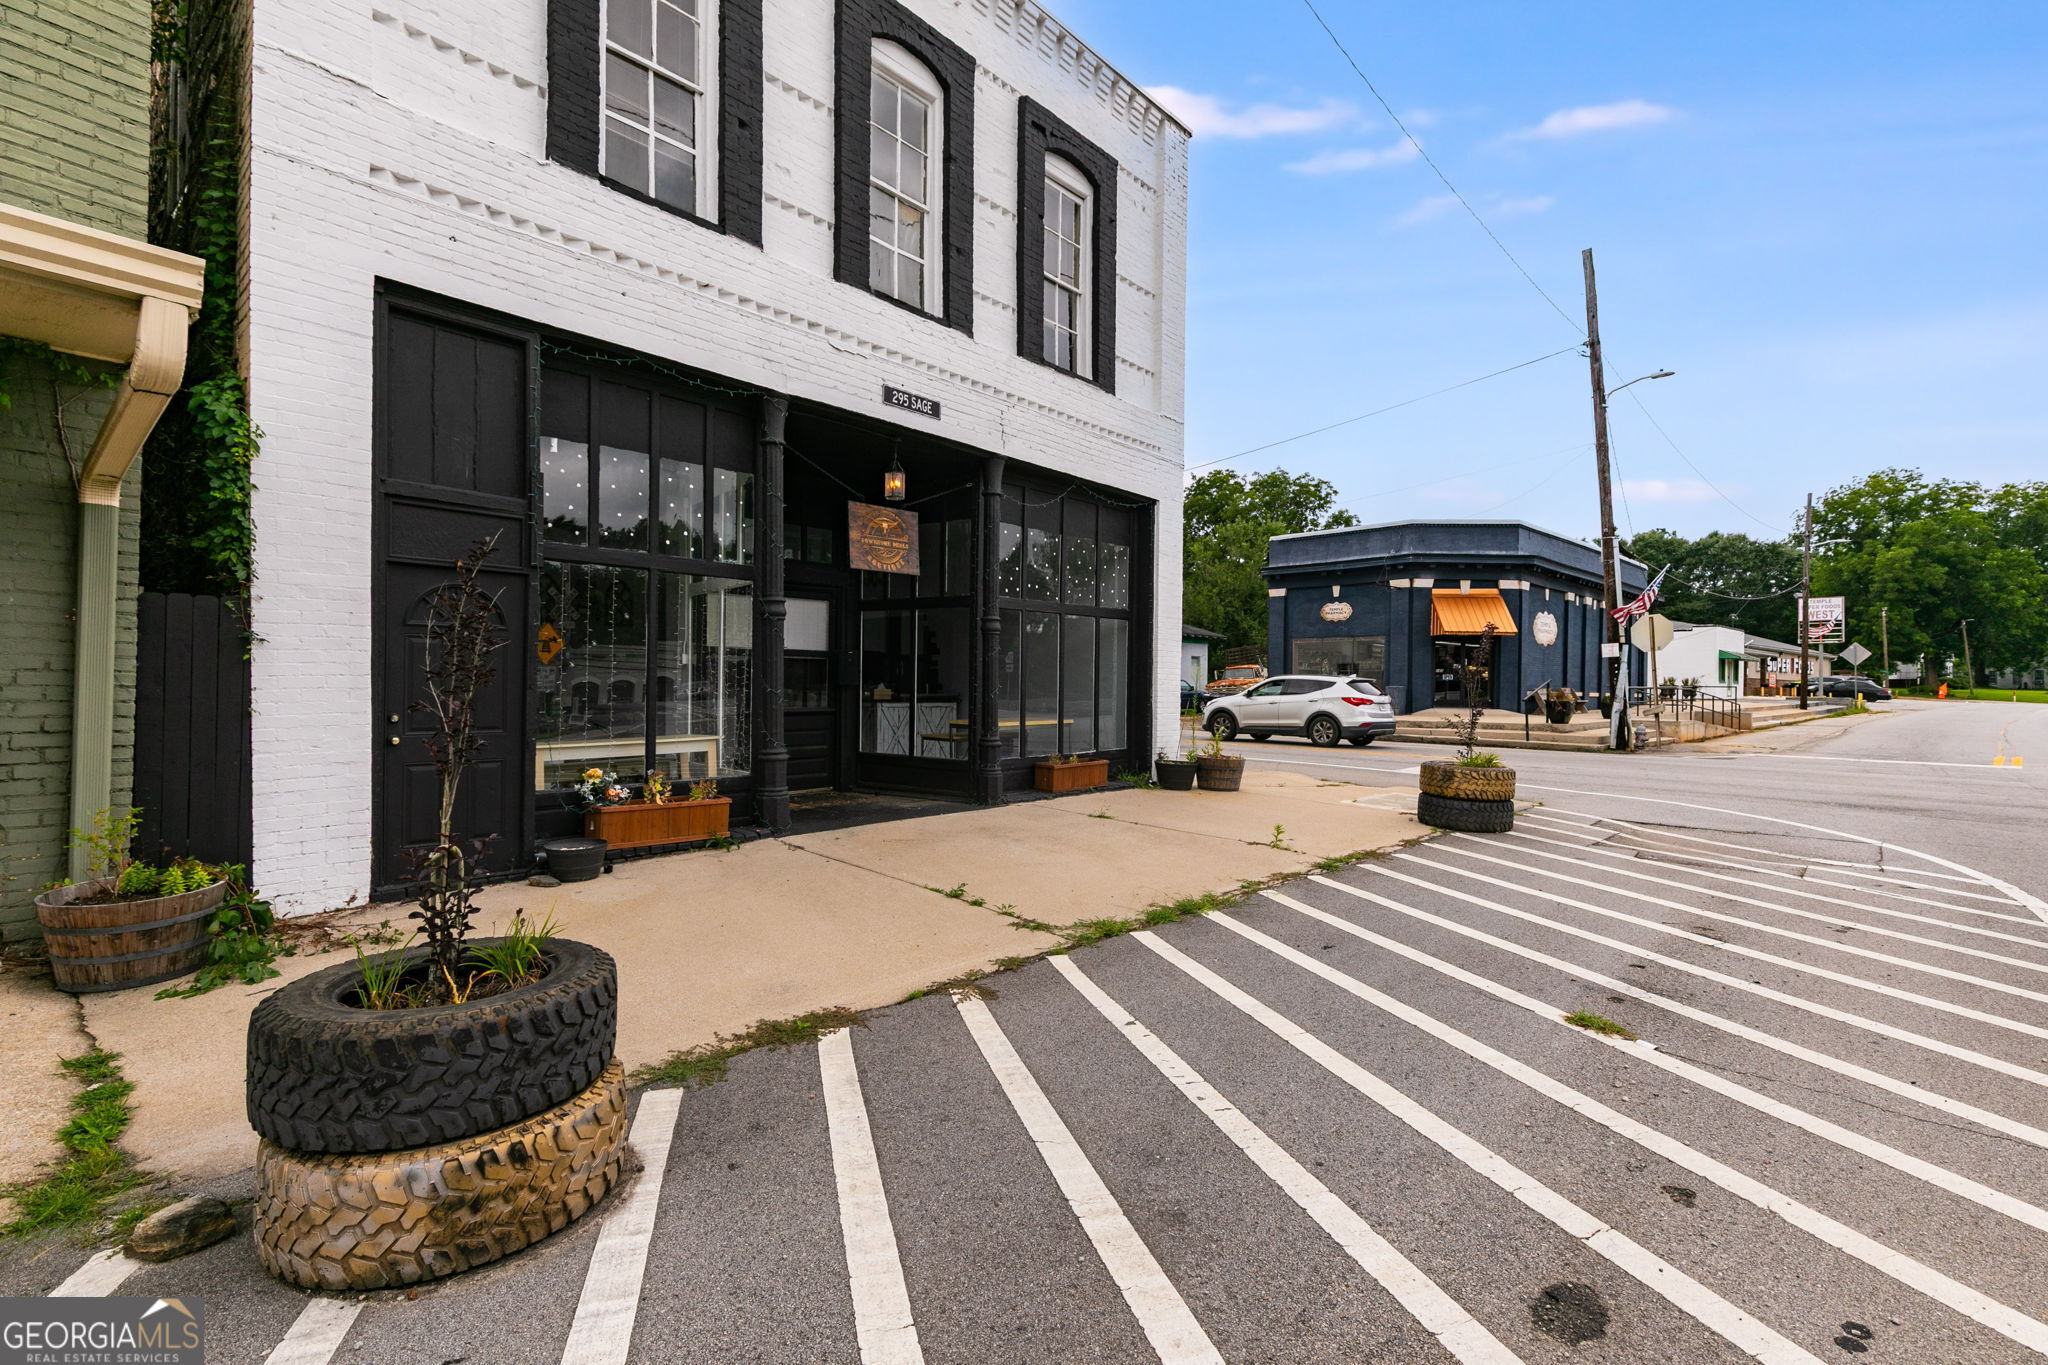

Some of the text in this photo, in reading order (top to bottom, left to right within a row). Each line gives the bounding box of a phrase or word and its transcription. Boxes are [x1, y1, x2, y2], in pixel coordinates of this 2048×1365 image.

[892, 391, 932, 414] 295 SAGE
[1767, 656, 1791, 673] SUPER
